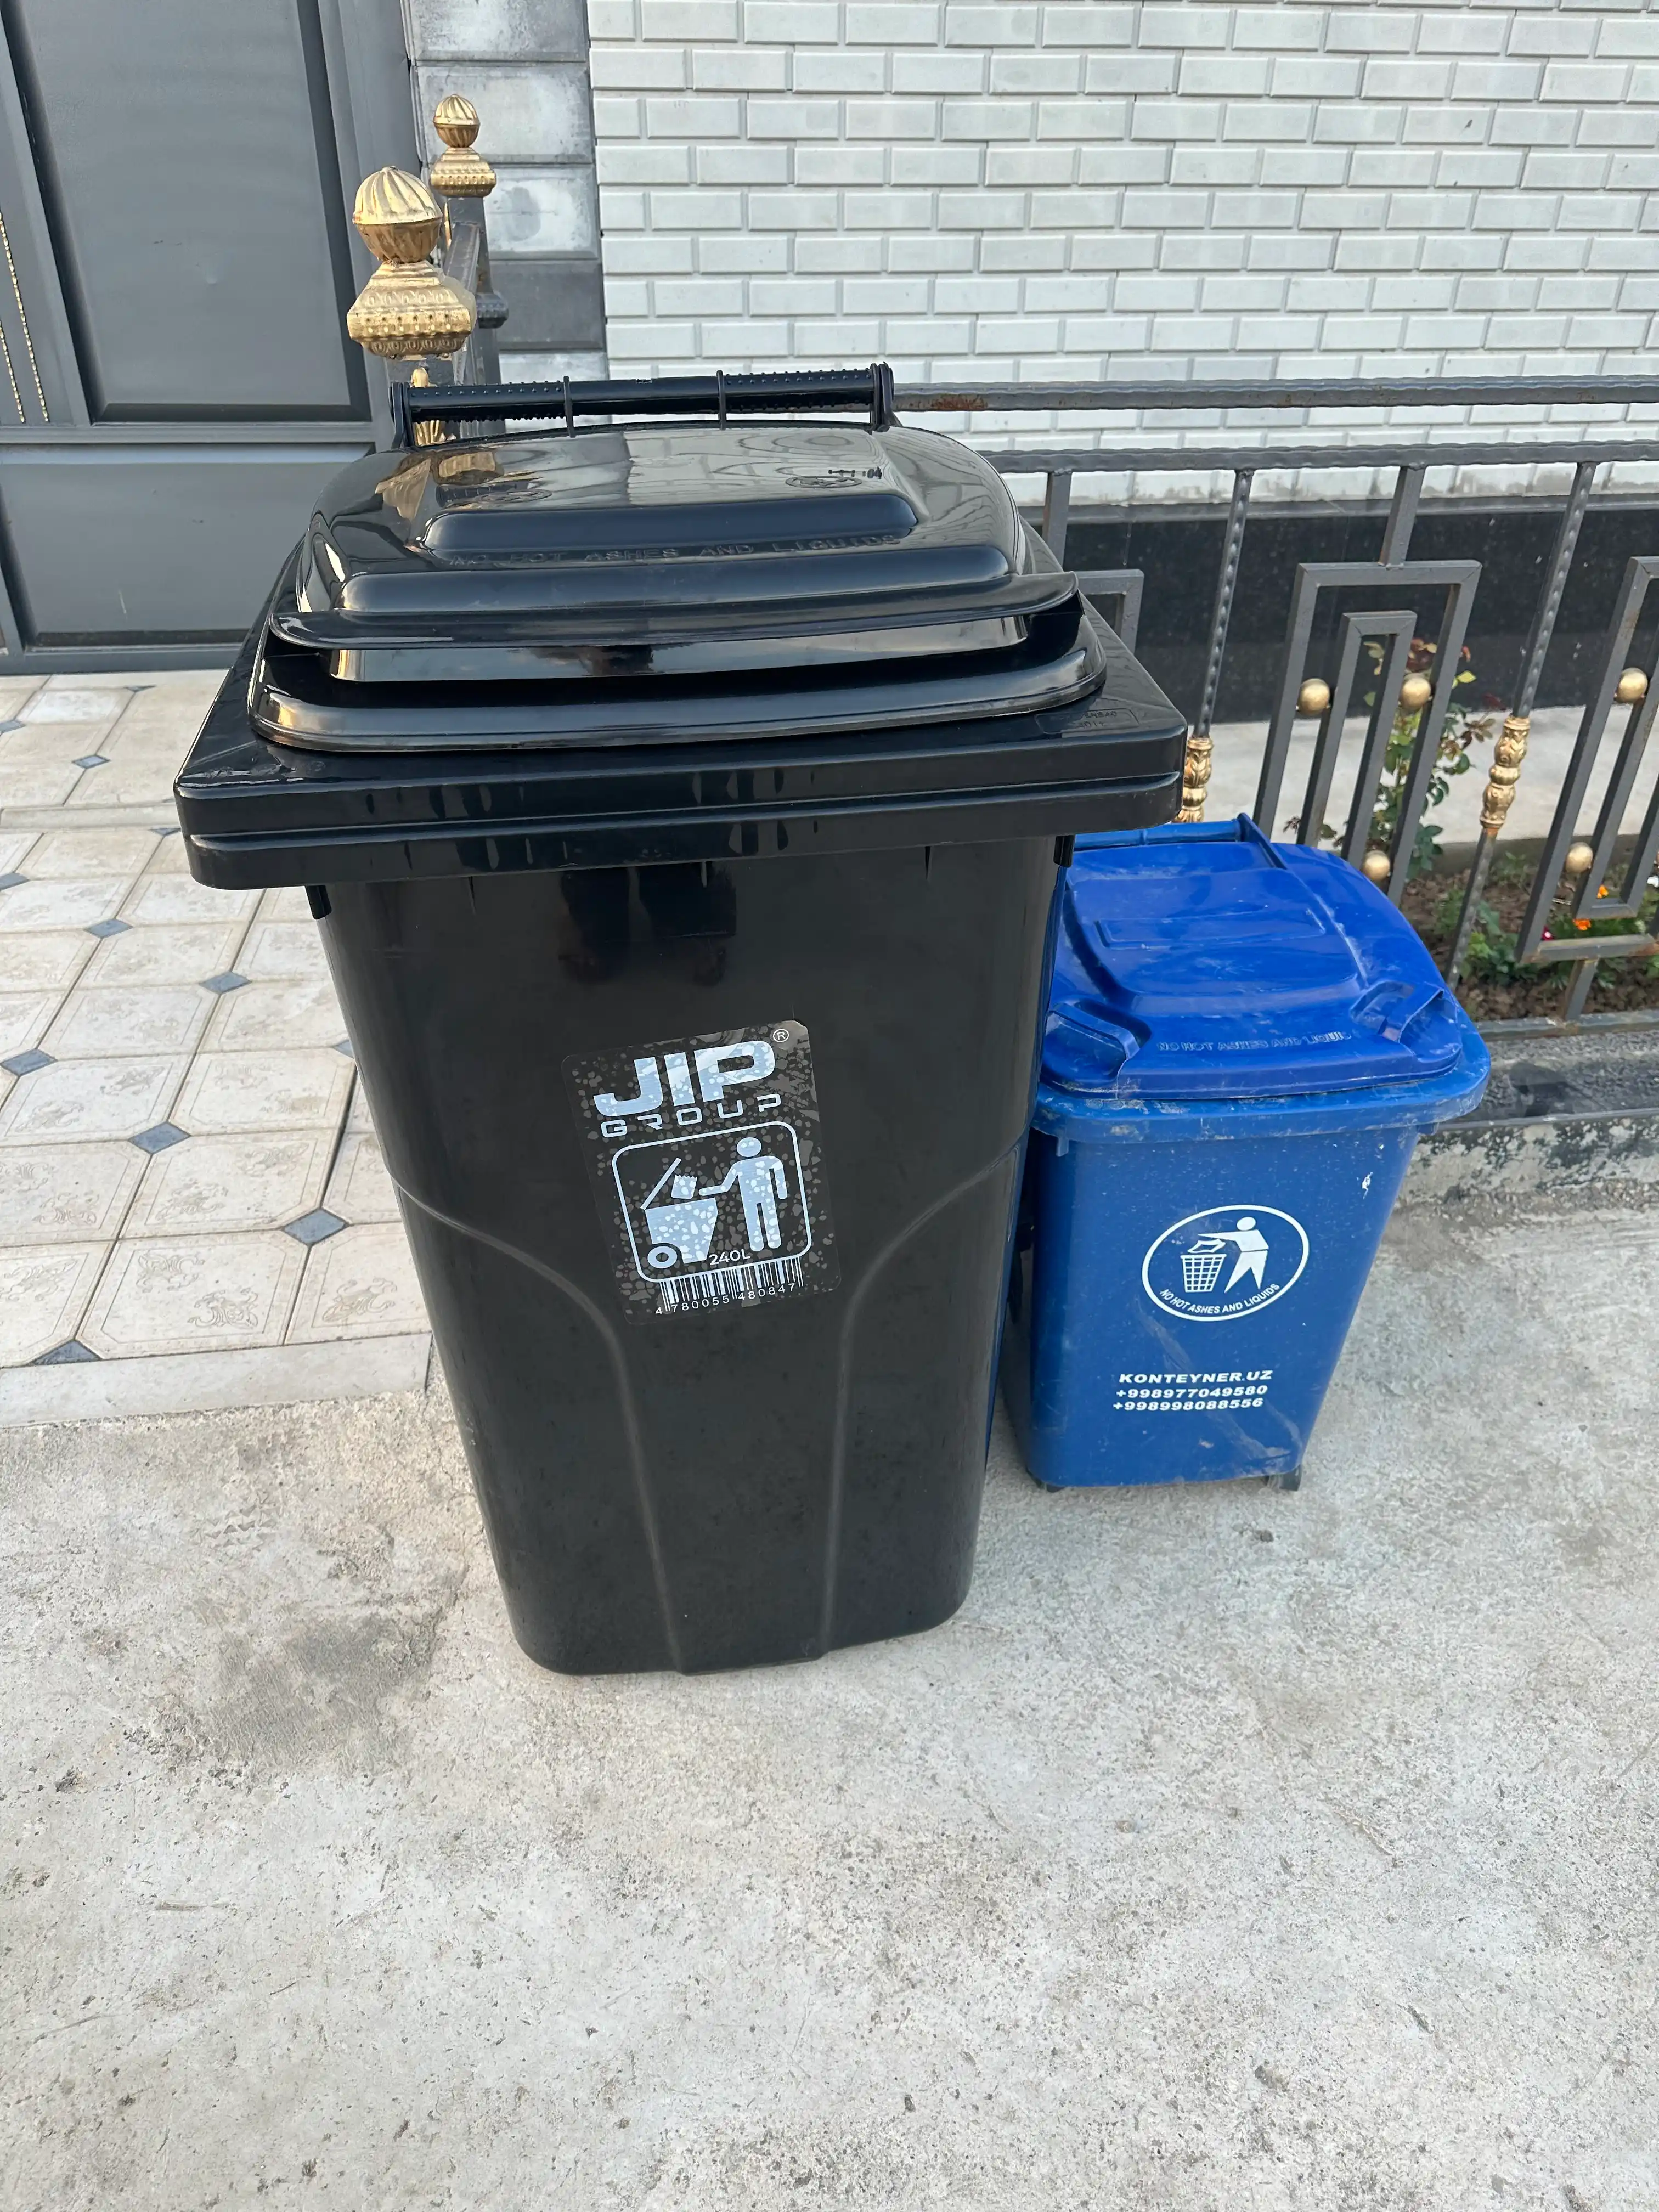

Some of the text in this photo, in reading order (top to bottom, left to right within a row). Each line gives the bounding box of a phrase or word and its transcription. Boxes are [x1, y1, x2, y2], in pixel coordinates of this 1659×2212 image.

[585, 548, 680, 562] ASHES
[699, 544, 754, 557] AND
[593, 1040, 775, 1117] JIP
[600, 1093, 782, 1138] GROUP
[708, 1248, 751, 1266] 240L
[1159, 1283, 1280, 1314] NO HOT ASHES AND LIQUIDS
[1119, 1369, 1273, 1384] KONTEYNER.UZ
[1115, 1385, 1268, 1399] +998977049580
[1113, 1397, 1263, 1412] +998998088556
